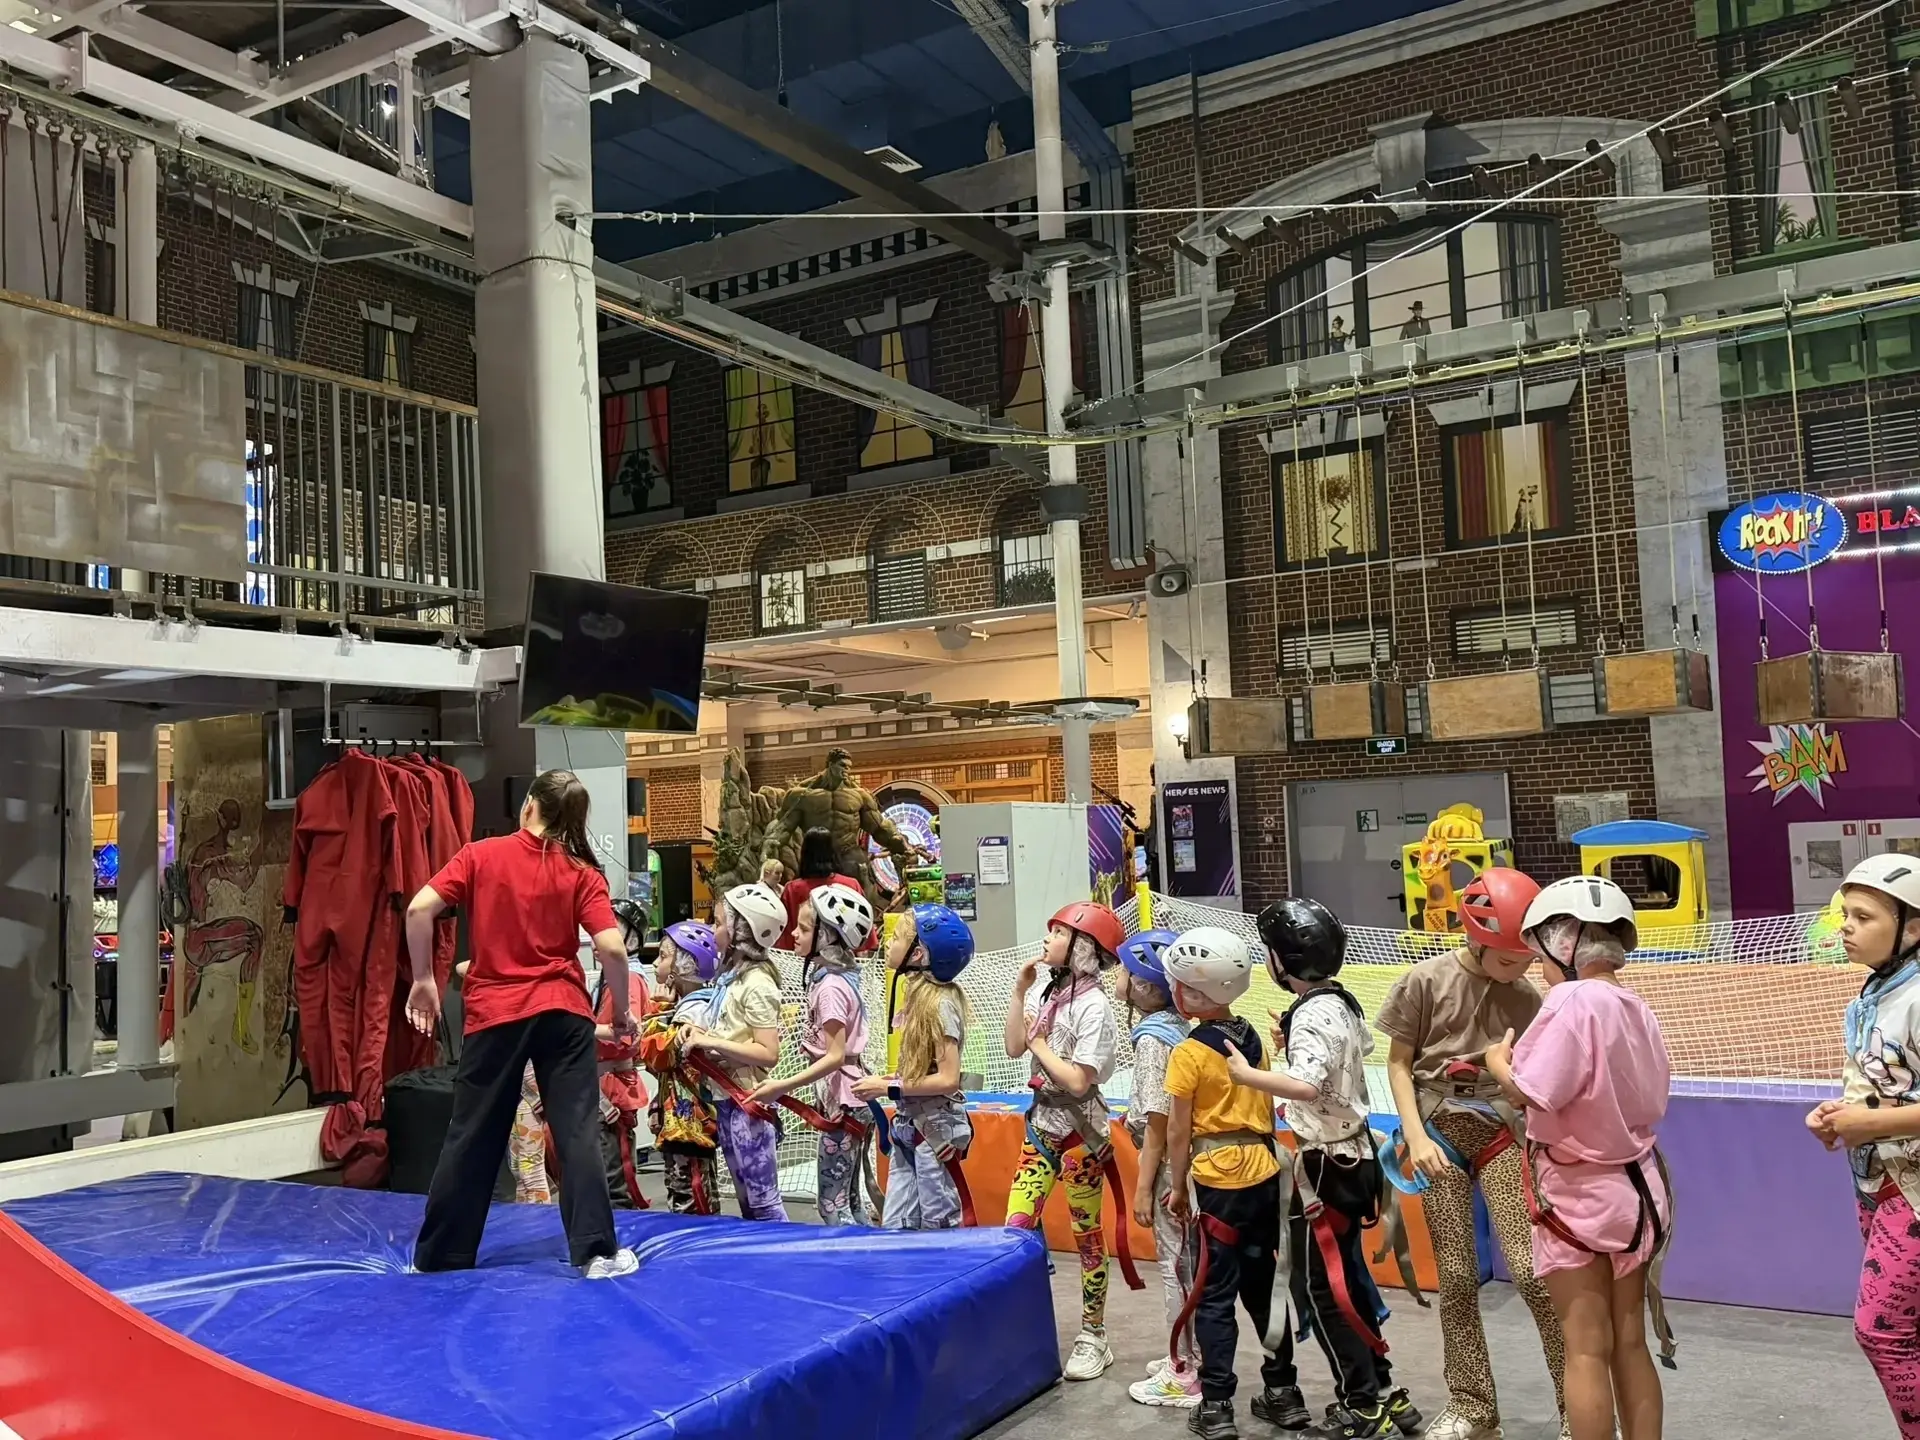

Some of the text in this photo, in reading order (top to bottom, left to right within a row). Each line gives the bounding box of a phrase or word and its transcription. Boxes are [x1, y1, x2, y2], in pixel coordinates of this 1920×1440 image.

[1763, 728, 1847, 791] BAM
[1200, 786, 1226, 795] NEWS
[1888, 1280, 1918, 1294] COOL
[1876, 1299, 1901, 1312] YOU
[1888, 1372, 1917, 1382] COOL
[1895, 1384, 1915, 1393] ARE
[1892, 1394, 1915, 1402] YOU
